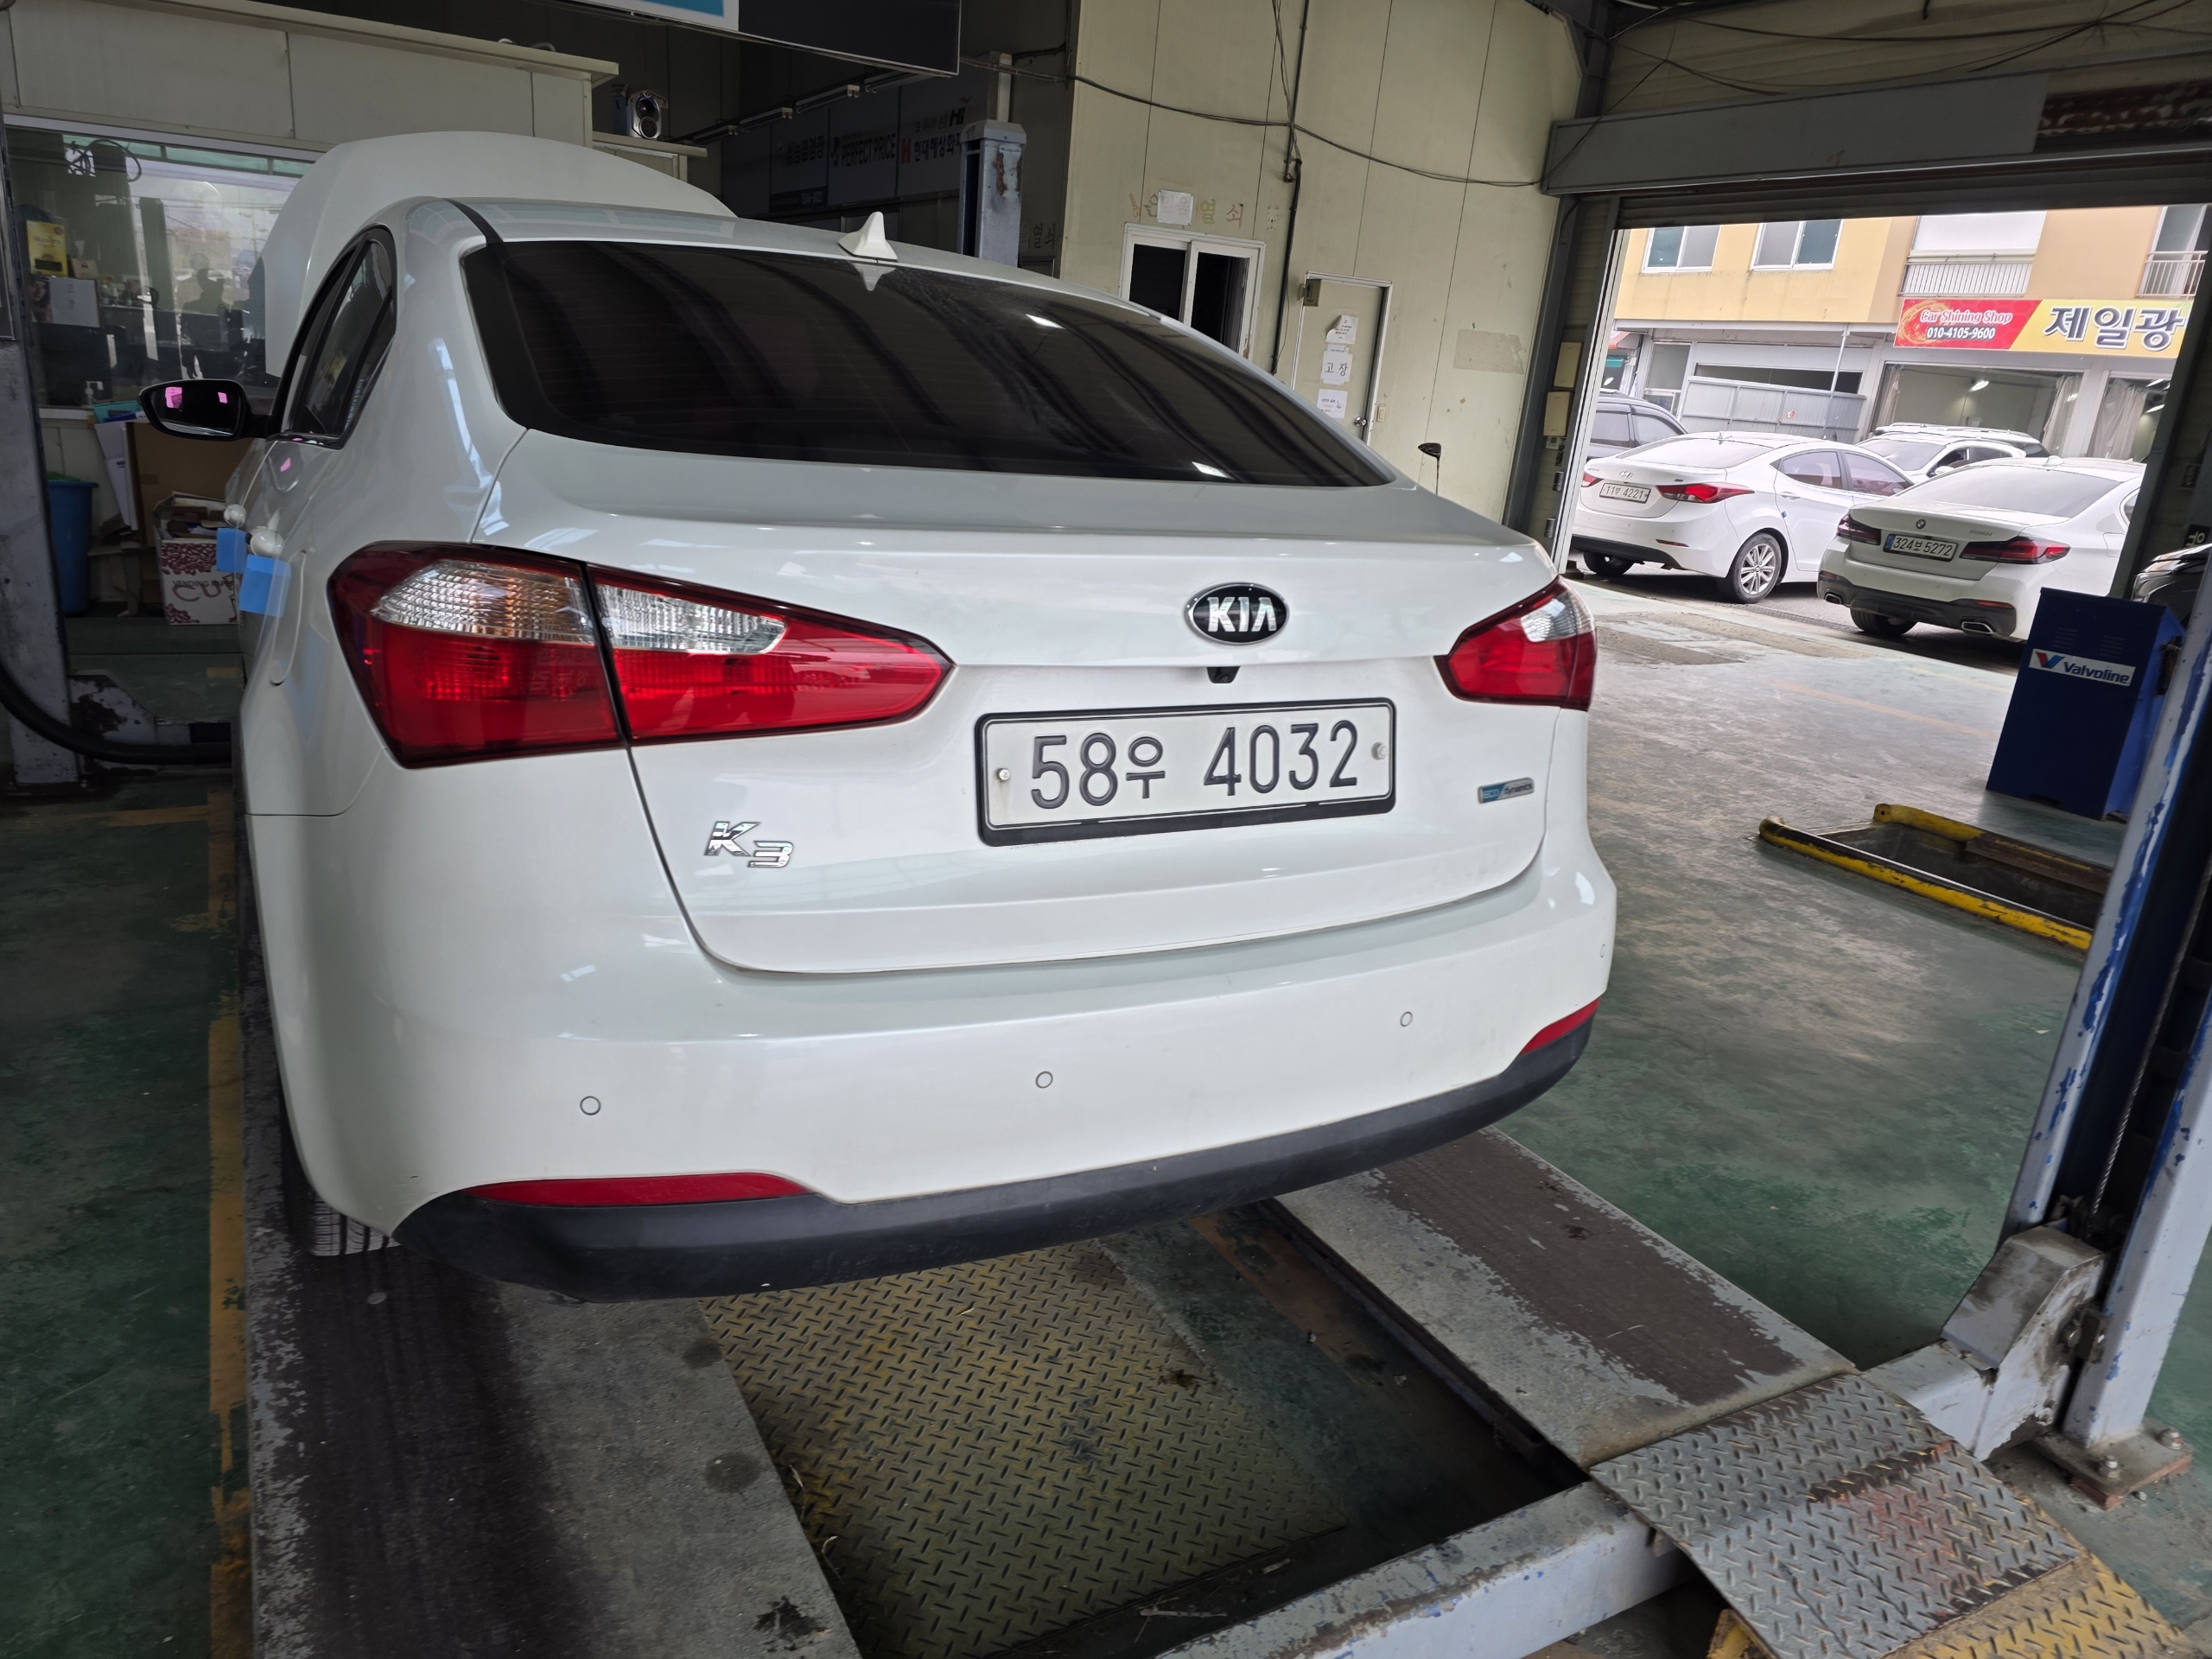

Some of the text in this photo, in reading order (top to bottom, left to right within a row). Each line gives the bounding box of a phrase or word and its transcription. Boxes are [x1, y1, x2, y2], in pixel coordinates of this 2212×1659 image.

[949, 107, 965, 127] Hi
[842, 133, 896, 168] PERFECT PRICE
[1920, 309, 2013, 326] Car Shining Shop
[1926, 327, 1996, 340] 010-4105-9600
[1623, 487, 1644, 499] 4221
[1923, 543, 1953, 556] 5272
[1207, 596, 1277, 632] KIA
[2063, 661, 2130, 684] Valvoline
[1031, 719, 1359, 810] 58우 4032
[703, 820, 794, 868] K3
